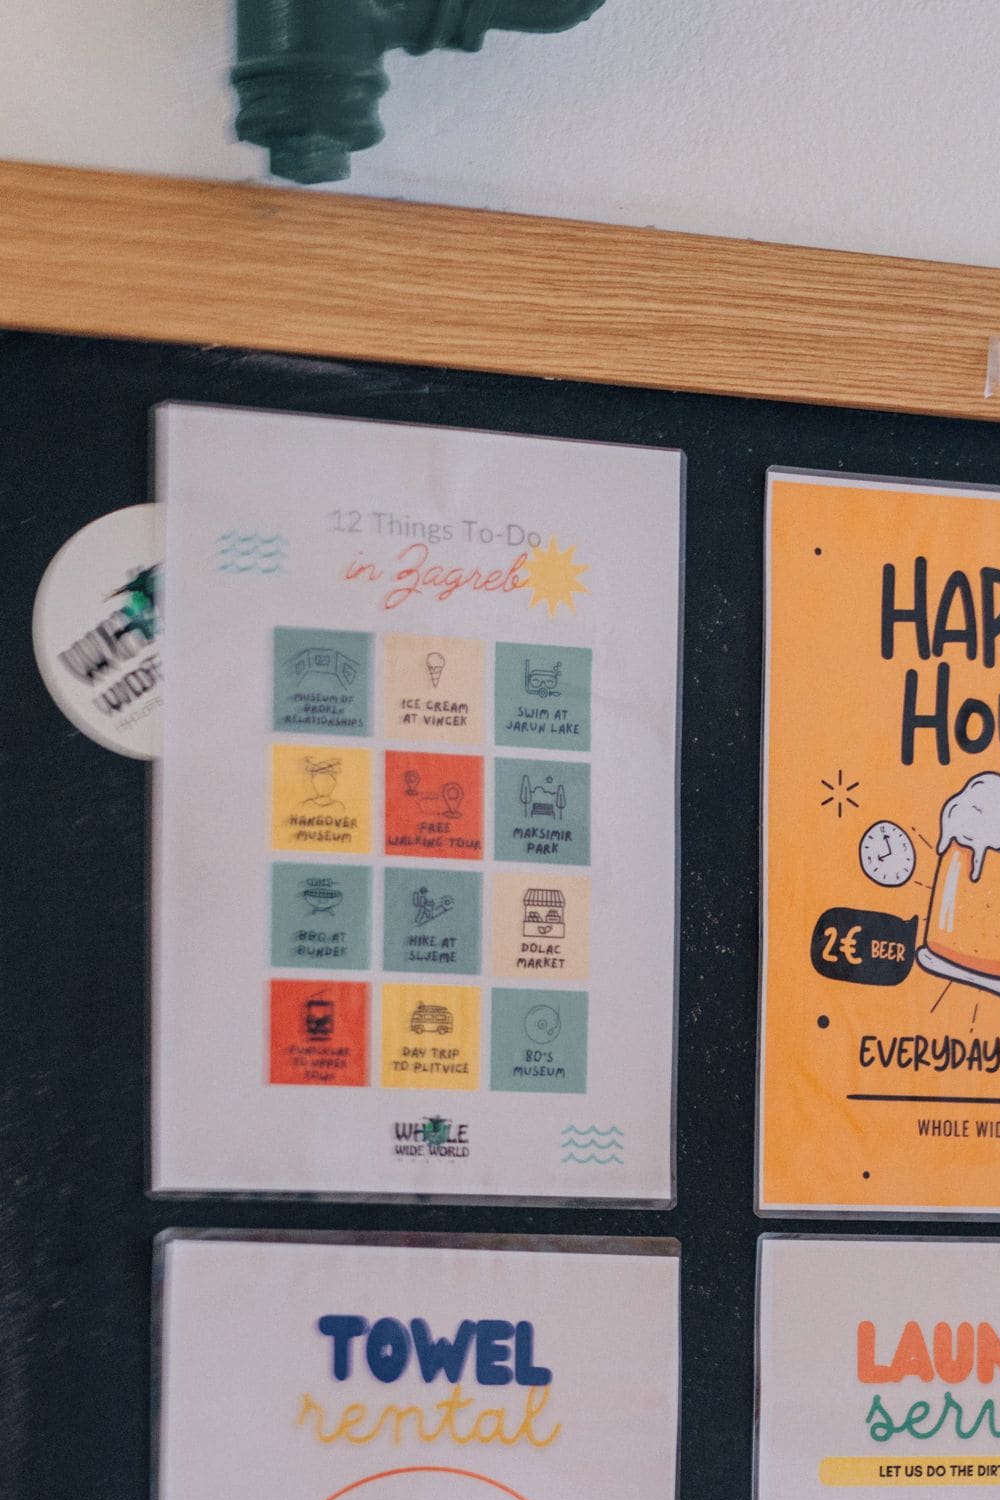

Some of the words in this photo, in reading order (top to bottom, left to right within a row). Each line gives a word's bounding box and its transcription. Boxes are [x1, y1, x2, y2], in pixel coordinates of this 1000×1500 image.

[331, 510, 362, 533] 12
[373, 512, 452, 544] Things
[462, 520, 541, 548] To-Do
[344, 551, 384, 581] in
[384, 543, 528, 610] Zagreb
[402, 699, 421, 709] ICE
[426, 700, 468, 713] CREAM
[518, 707, 549, 719] SWIM
[554, 709, 568, 719] AT
[403, 714, 419, 724] AT
[424, 715, 467, 727] VINCEK
[506, 721, 546, 733] JARUN
[551, 723, 579, 735] LAKE
[297, 830, 352, 842] MUSEUM
[513, 827, 572, 841] MAKSIMIR
[527, 842, 558, 854] PARK
[408, 934, 435, 947] HIKE
[441, 937, 457, 947] AT
[822, 926, 862, 965] 2€
[871, 939, 905, 962] BEER
[522, 942, 560, 954] DOLAC
[517, 957, 565, 968] MARKET
[403, 1046, 427, 1058] DAY
[432, 1047, 459, 1059] TRIP
[859, 1035, 1000, 1072] EVERYDAY
[513, 1065, 565, 1078] MUSEUM
[917, 1119, 969, 1138] WHOLE
[318, 1314, 553, 1386] TOWEL
[297, 1383, 561, 1448] rental
[879, 1465, 901, 1478] LET
[905, 1465, 923, 1478] US
[927, 1465, 945, 1478] DO
[948, 1464, 973, 1477] THE
